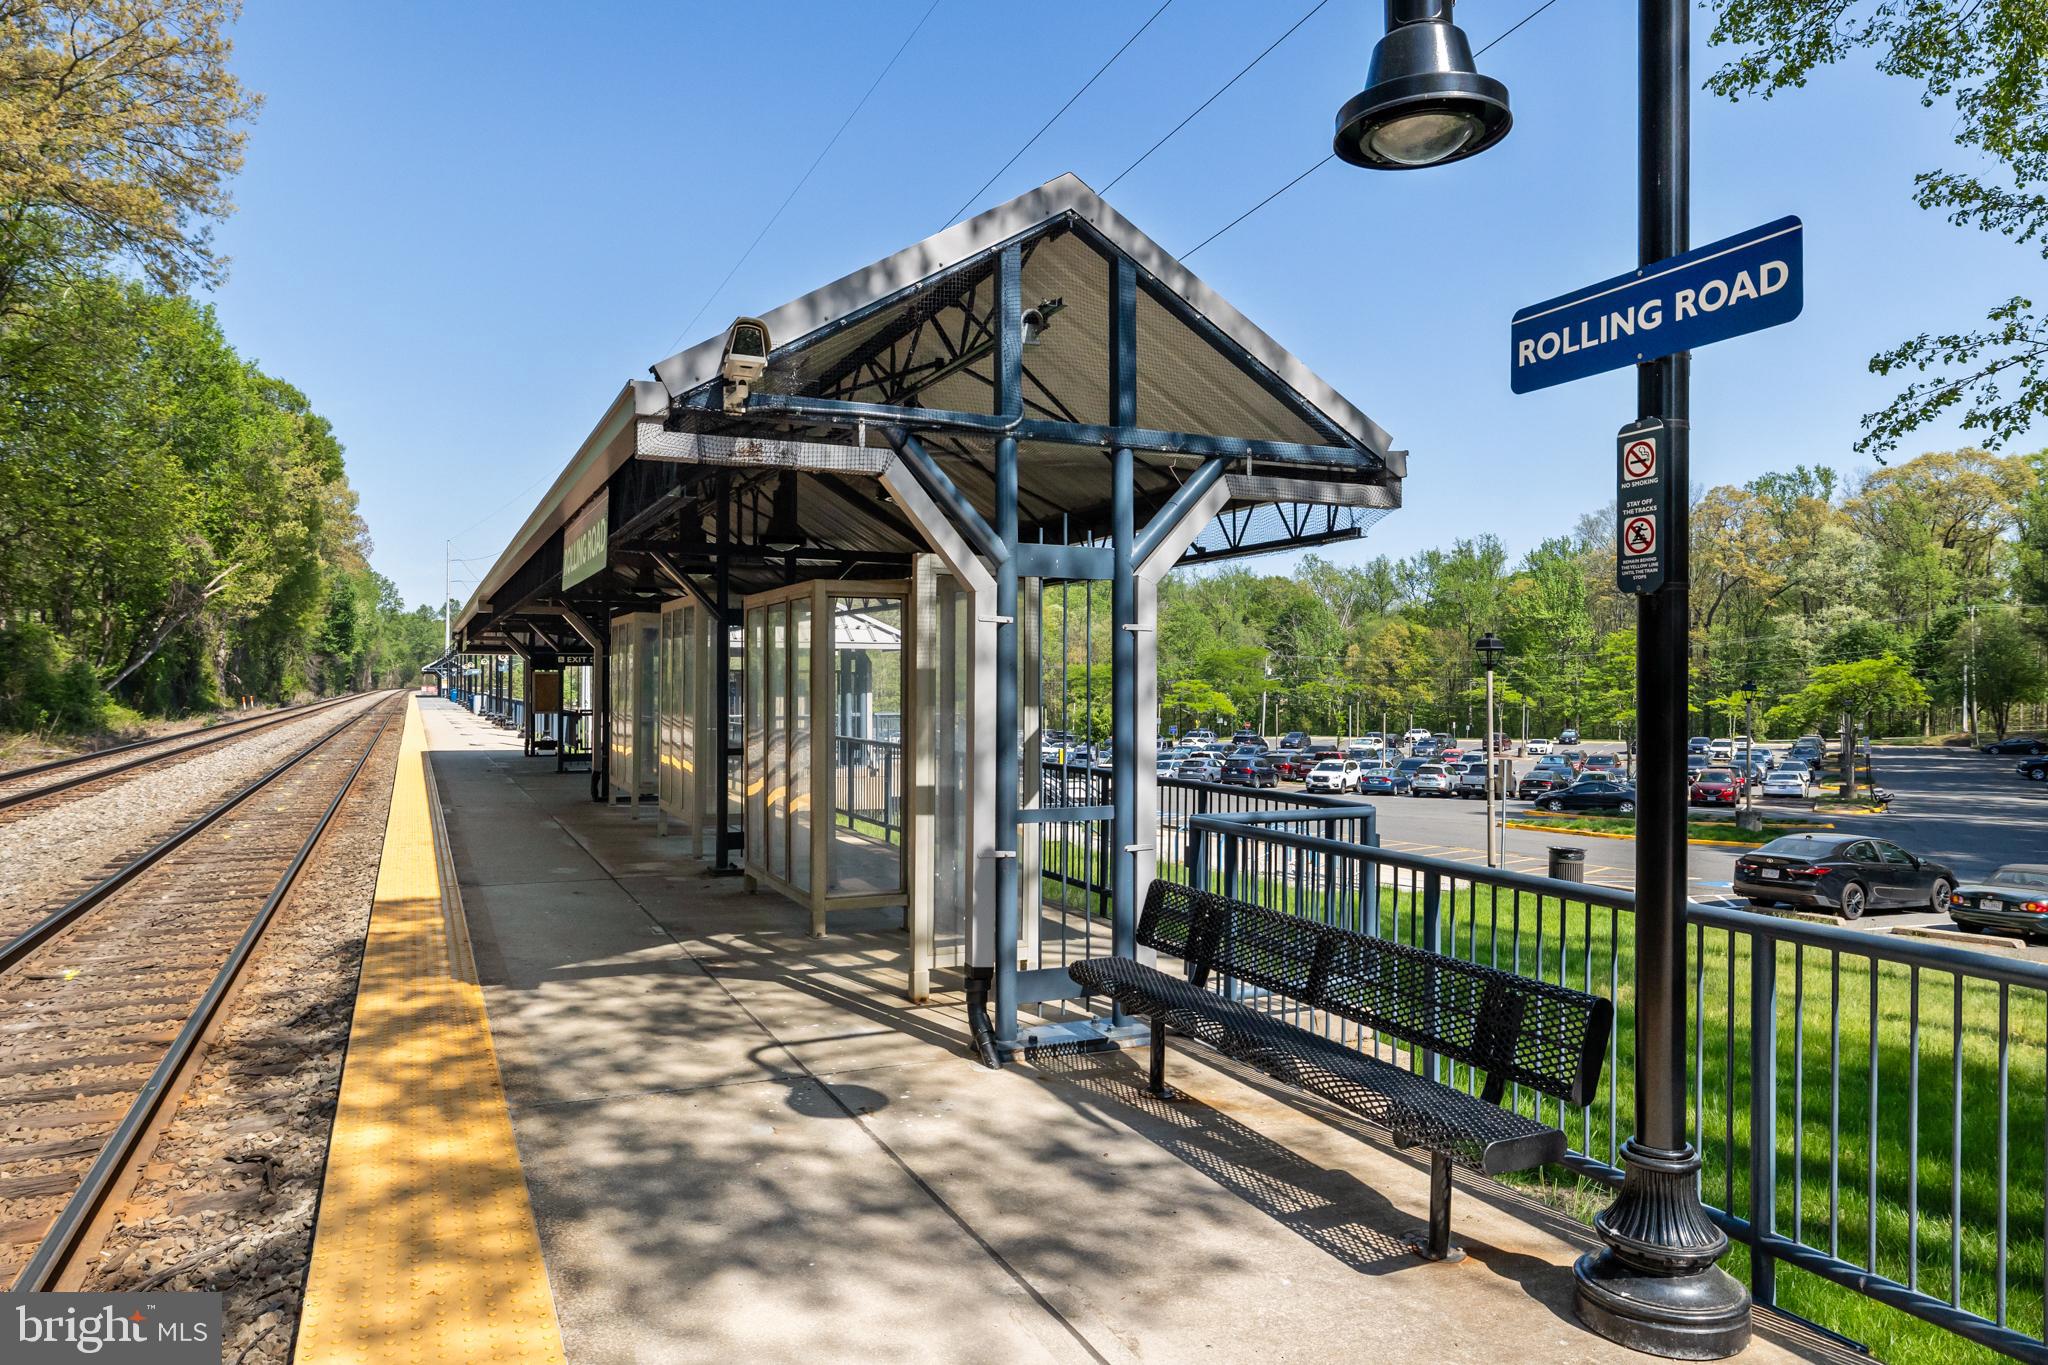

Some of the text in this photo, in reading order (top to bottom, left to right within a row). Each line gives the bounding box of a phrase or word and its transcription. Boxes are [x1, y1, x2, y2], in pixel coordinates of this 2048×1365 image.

[1518, 260, 1790, 367] ROLLING ROAD
[1631, 477, 1659, 488] SMOKING
[1626, 500, 1640, 508] STAY
[1635, 505, 1657, 514] TRACKS
[587, 518, 606, 561] ROAD
